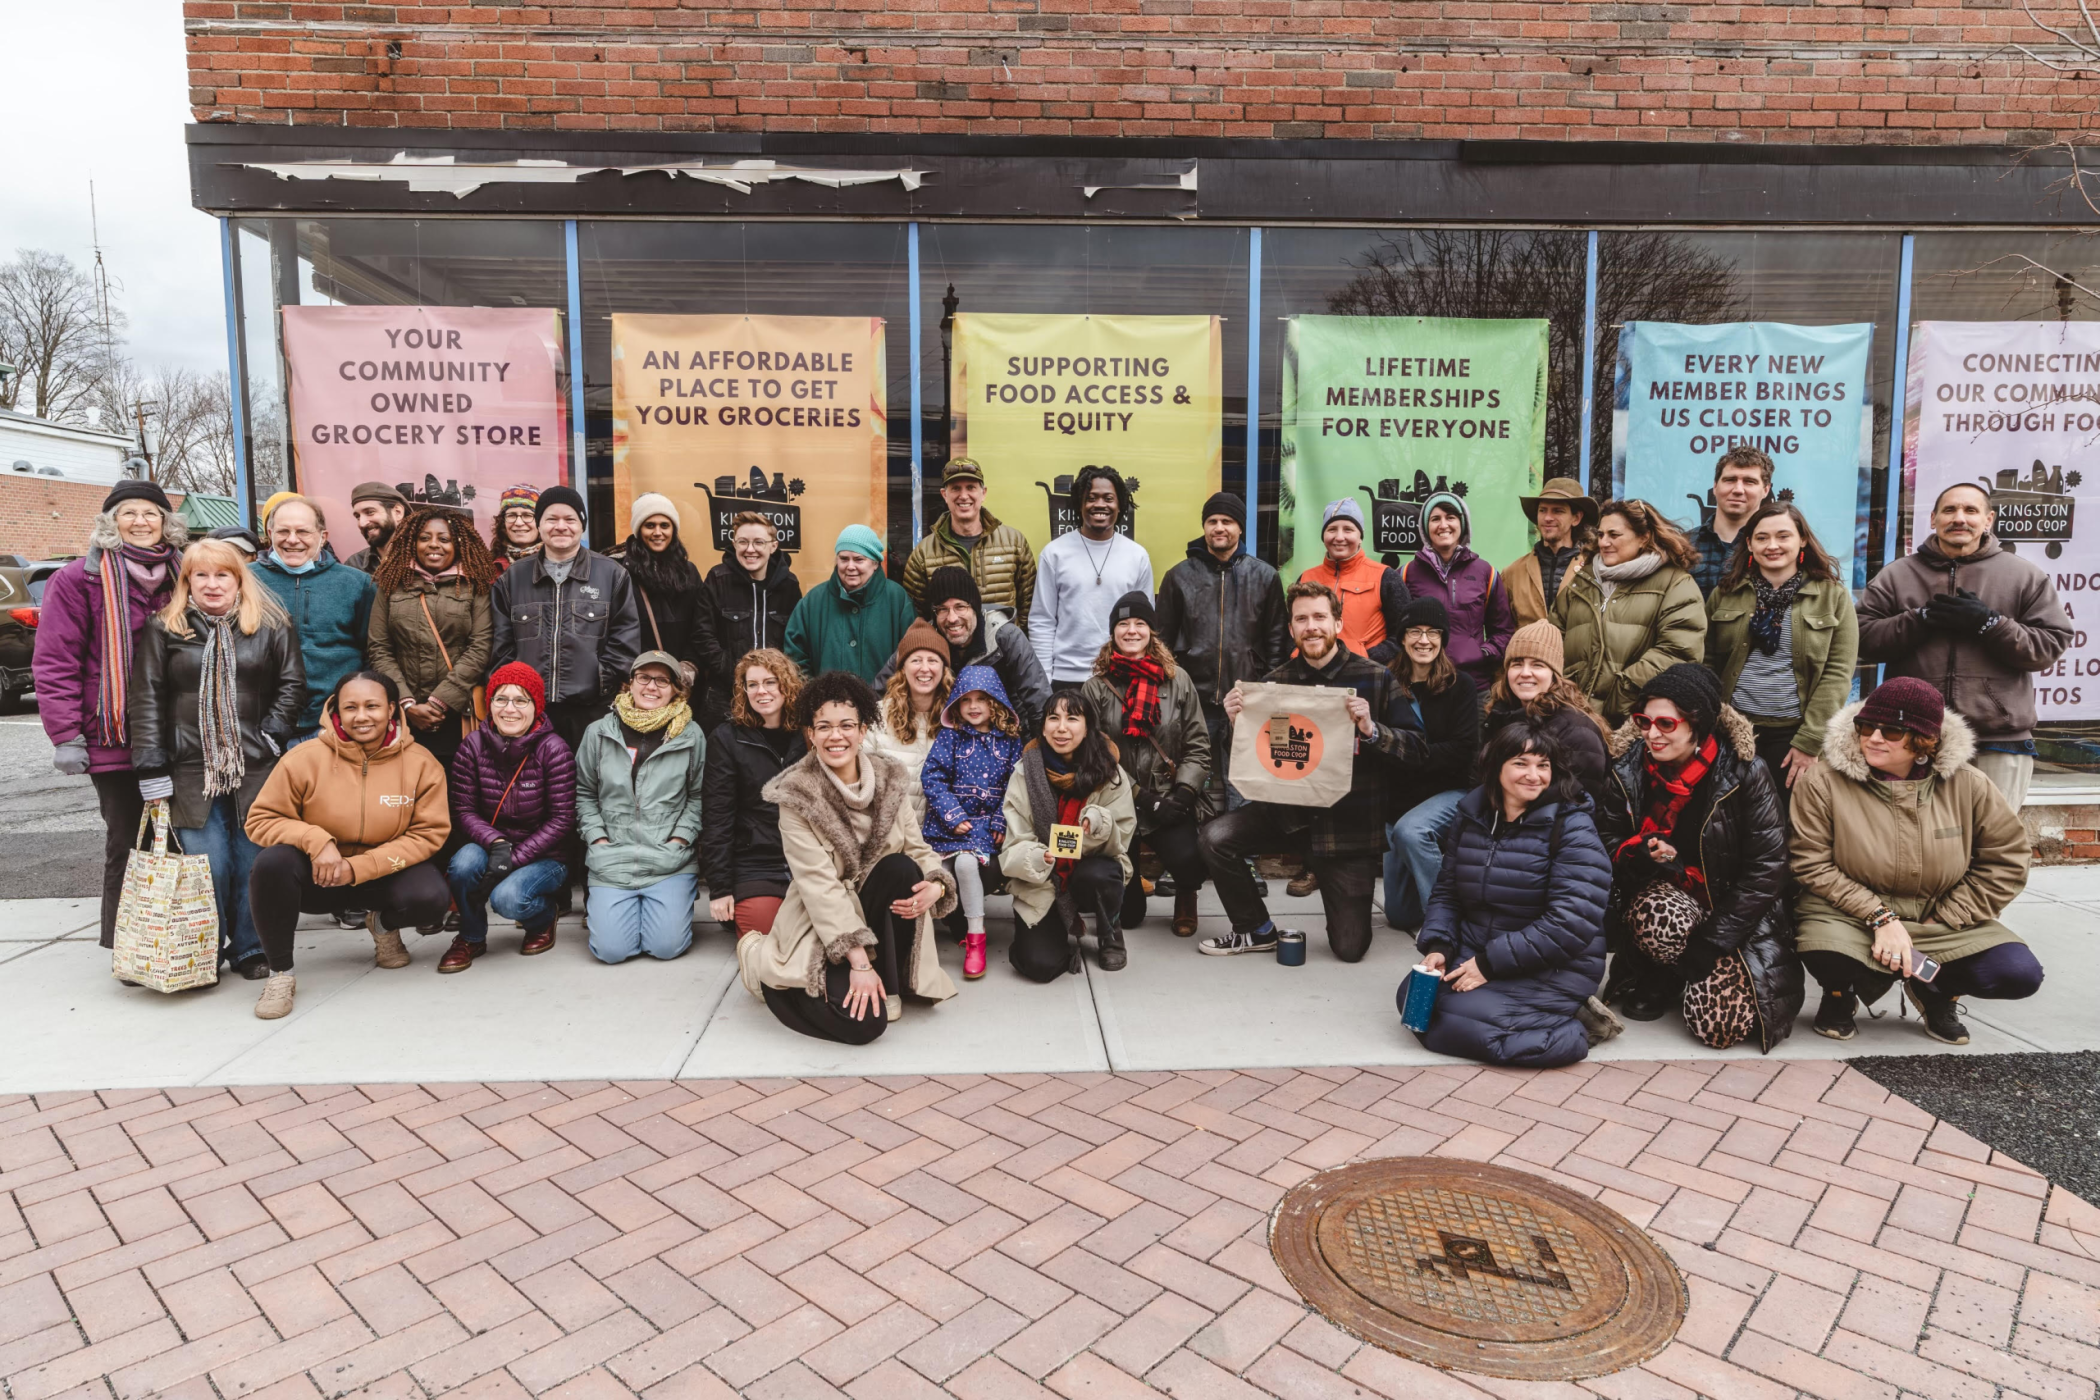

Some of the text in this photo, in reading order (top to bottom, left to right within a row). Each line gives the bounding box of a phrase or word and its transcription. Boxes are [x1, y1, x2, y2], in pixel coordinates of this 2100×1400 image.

[385, 329, 463, 349] YOUR
[642, 350, 853, 372] AN AFFORDABLE
[1007, 356, 1169, 377] SUPPORTING
[1366, 357, 1470, 377] LIFETIME
[1685, 354, 1825, 374] EVERY NEW
[1963, 353, 2100, 373] CONNECTIN
[339, 361, 510, 382] COMMUNITY
[660, 378, 838, 399] PLACE TO GET
[986, 384, 1192, 404] FOOD ACCESS &
[1326, 387, 1500, 408] MEMBERSHIPS
[1650, 381, 1846, 401] MEMBER BRINGS
[1936, 383, 2100, 402] OUR COMMUN
[370, 393, 473, 413] OWNED
[635, 405, 861, 427] YOUR GROCERIES
[1043, 411, 1133, 435] EQUITY
[1661, 408, 1832, 428] US CLOSER TO
[1943, 413, 2100, 432] THROUGH FO
[311, 424, 541, 446] GROCERY STORE
[1322, 417, 1510, 439] FOR EVERYONE
[1689, 435, 1800, 454] OPENING
[720, 511, 794, 526] KITON
[1998, 503, 2069, 517] KINGSTON
[1381, 514, 1418, 528] KING
[1997, 520, 2033, 532] FOOD
[1381, 531, 1417, 543] FOOD
[2074, 658, 2100, 676] LO
[2033, 687, 2082, 705] TOS
